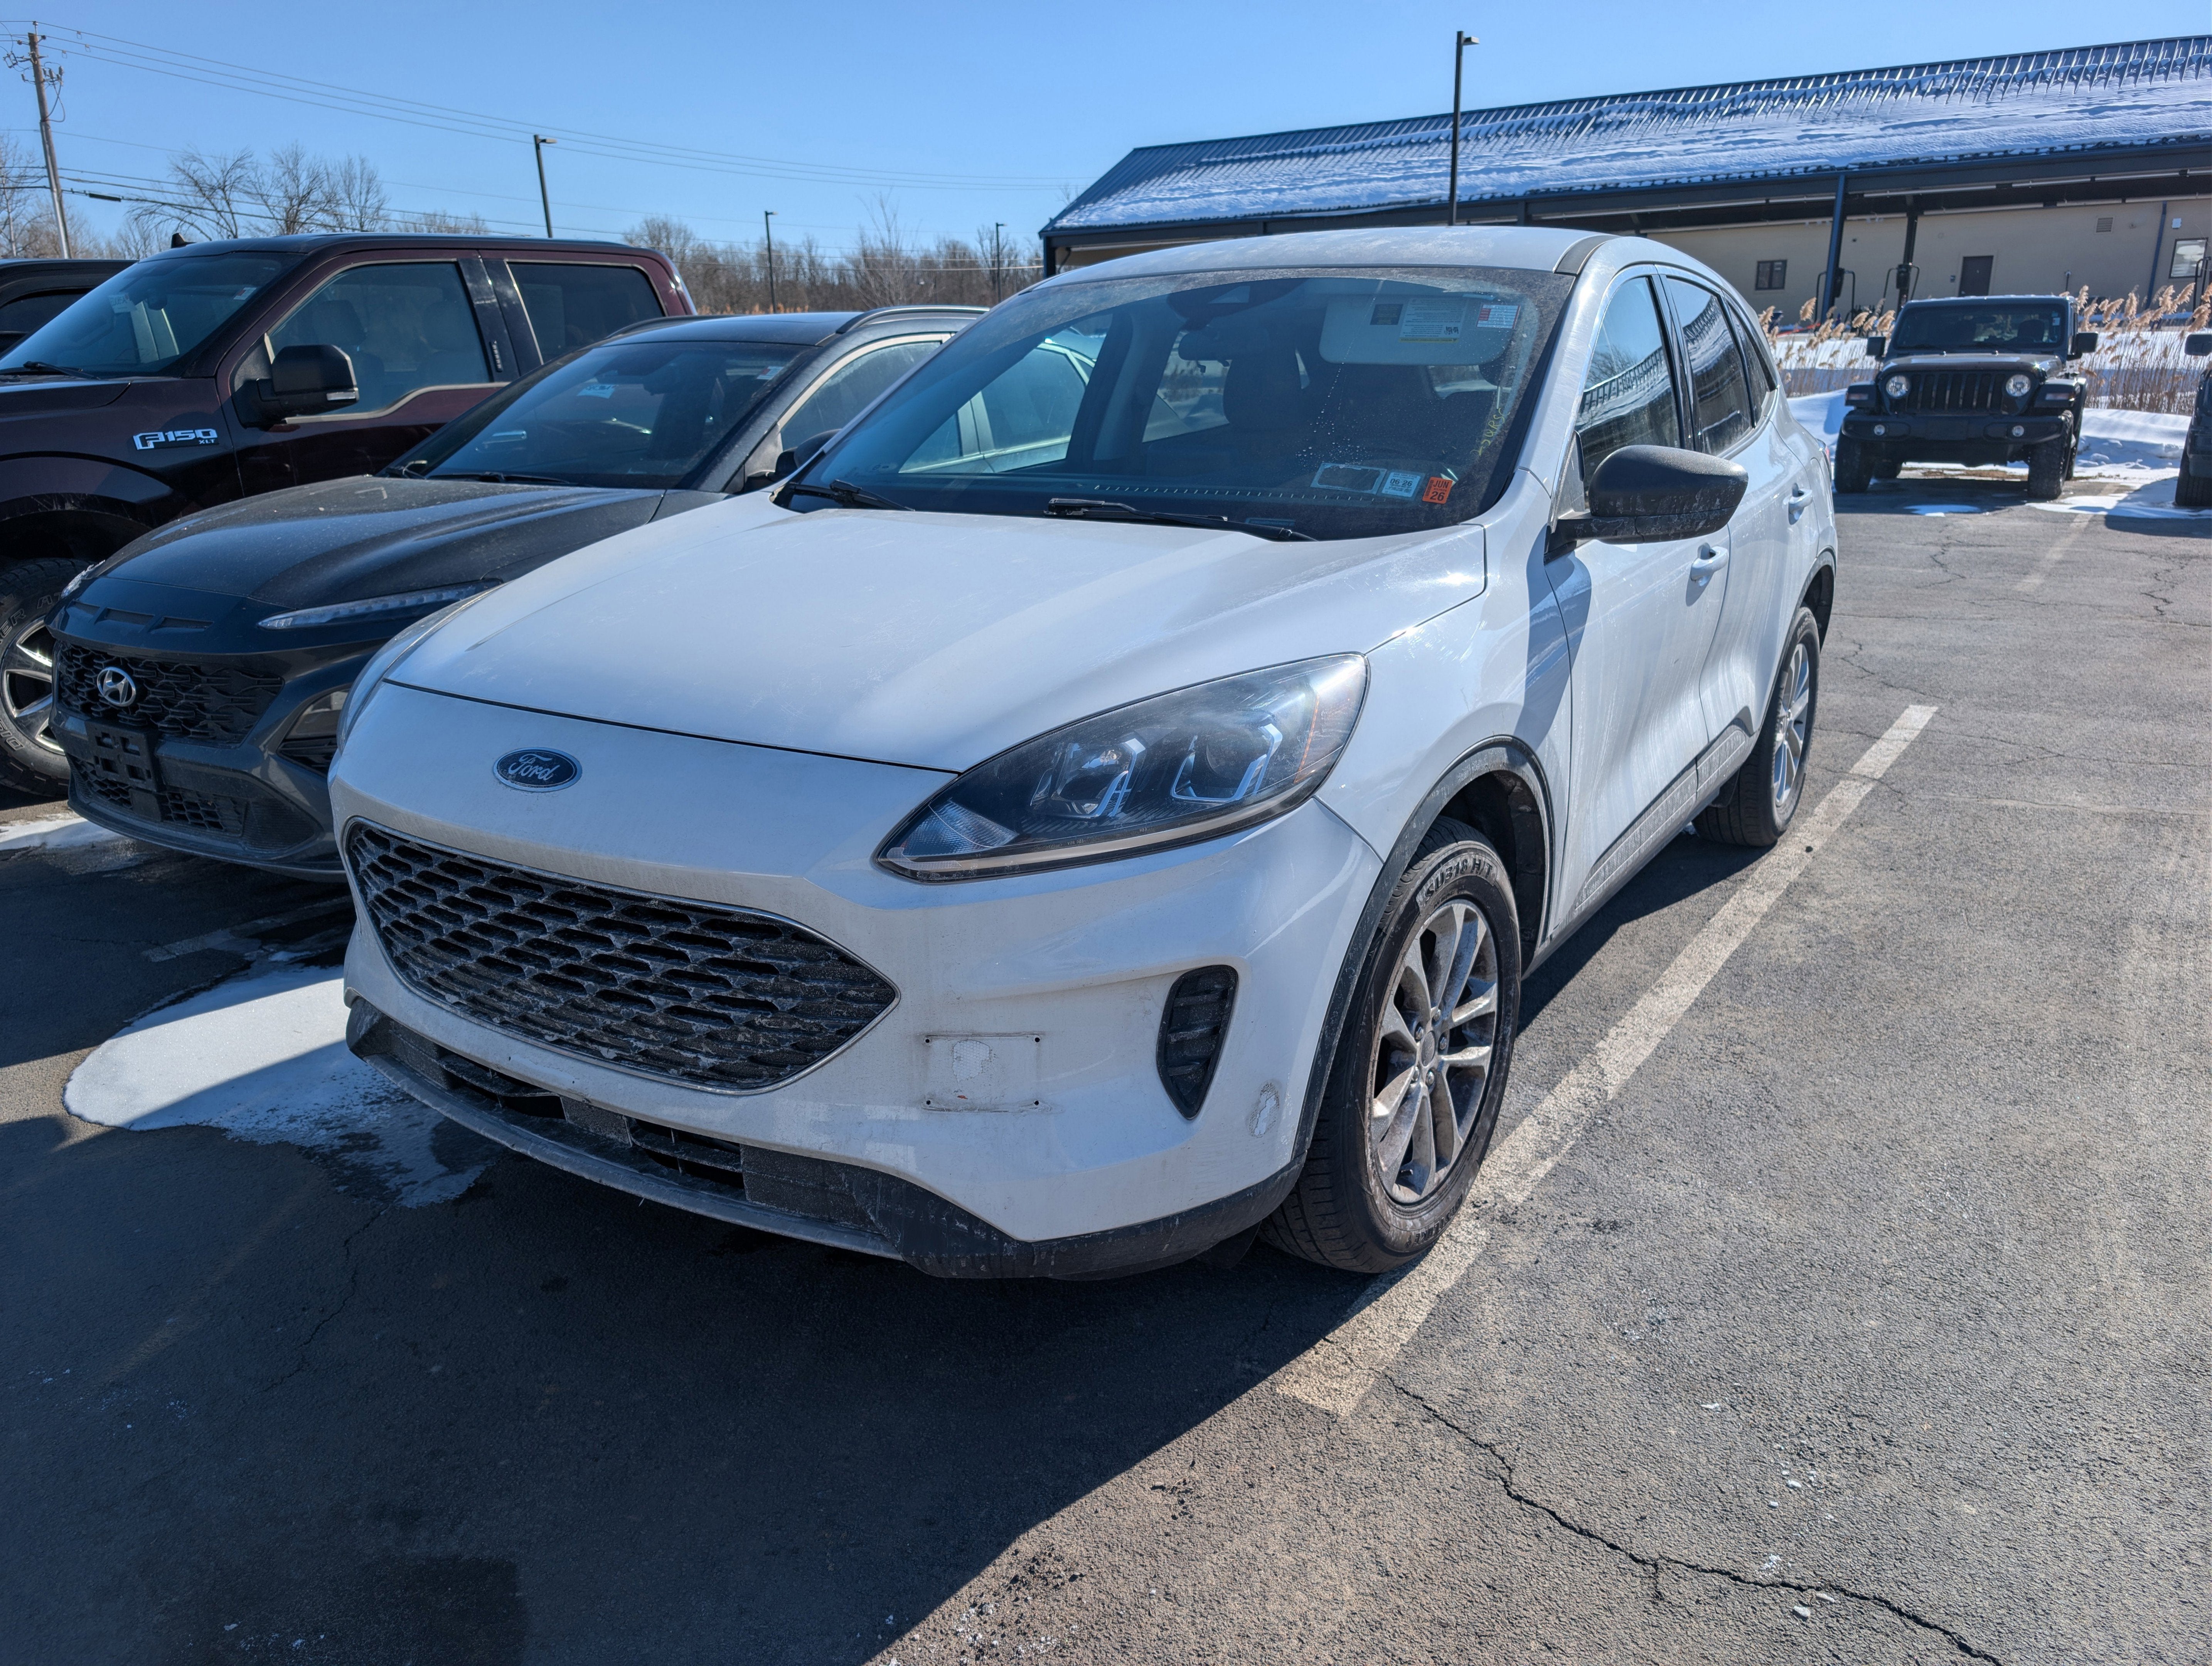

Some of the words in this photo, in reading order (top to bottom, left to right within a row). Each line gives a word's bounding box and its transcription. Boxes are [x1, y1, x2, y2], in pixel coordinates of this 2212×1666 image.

[1430, 491, 1445, 501] 26
[1433, 480, 1449, 489] JUN
[0, 609, 26, 644] ER
[508, 753, 561, 781] Ford
[1425, 858, 1468, 904] SU318
[1470, 858, 1493, 879] H/T
[1413, 1193, 1463, 1245] WESTLAKE
